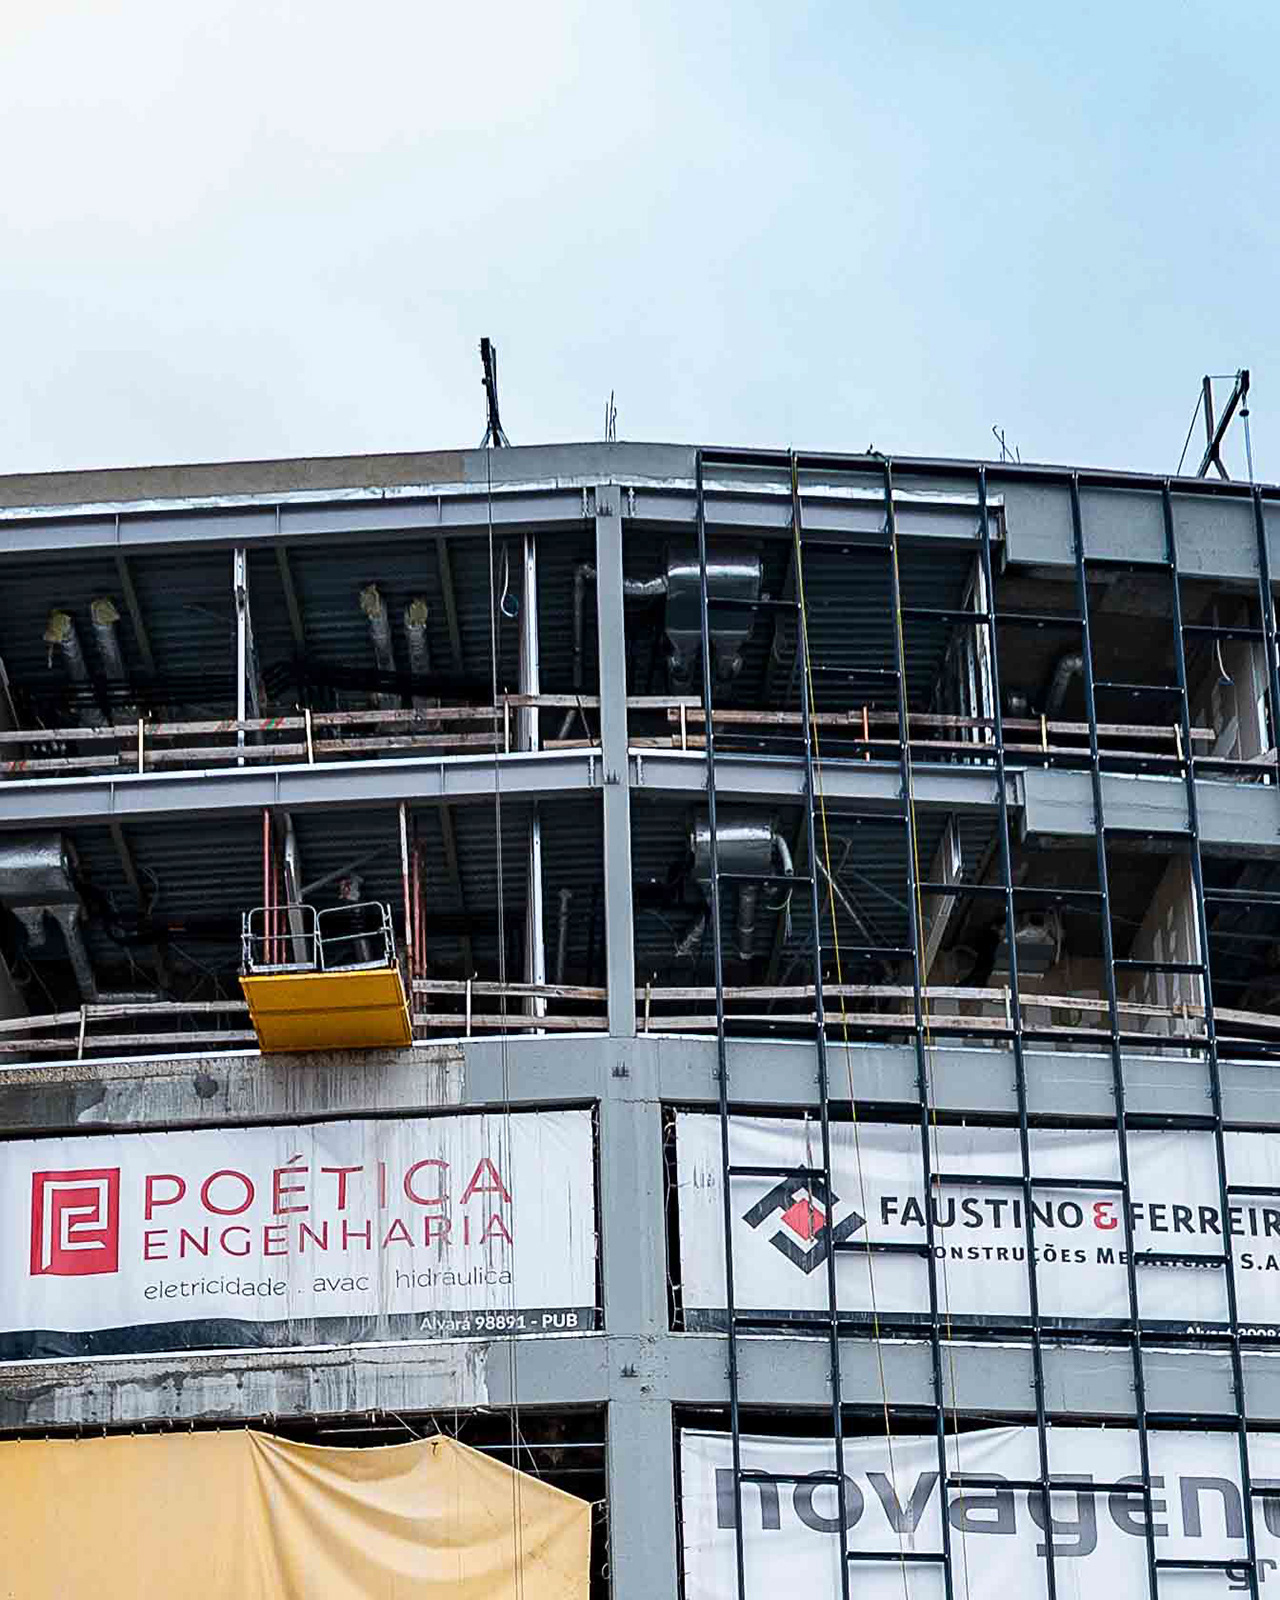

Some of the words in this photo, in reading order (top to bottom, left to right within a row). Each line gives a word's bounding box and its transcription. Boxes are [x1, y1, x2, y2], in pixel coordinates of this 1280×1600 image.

[144, 1153, 513, 1221] POÉTICA
[880, 1196, 1085, 1229] FAUSTINO
[144, 1213, 514, 1261] ENGENHARIA
[144, 1276, 287, 1300] eletricidade
[312, 1273, 370, 1293] avac
[420, 1316, 470, 1331] Alvará
[475, 1315, 526, 1330] 98891
[542, 1313, 578, 1328] PUB
